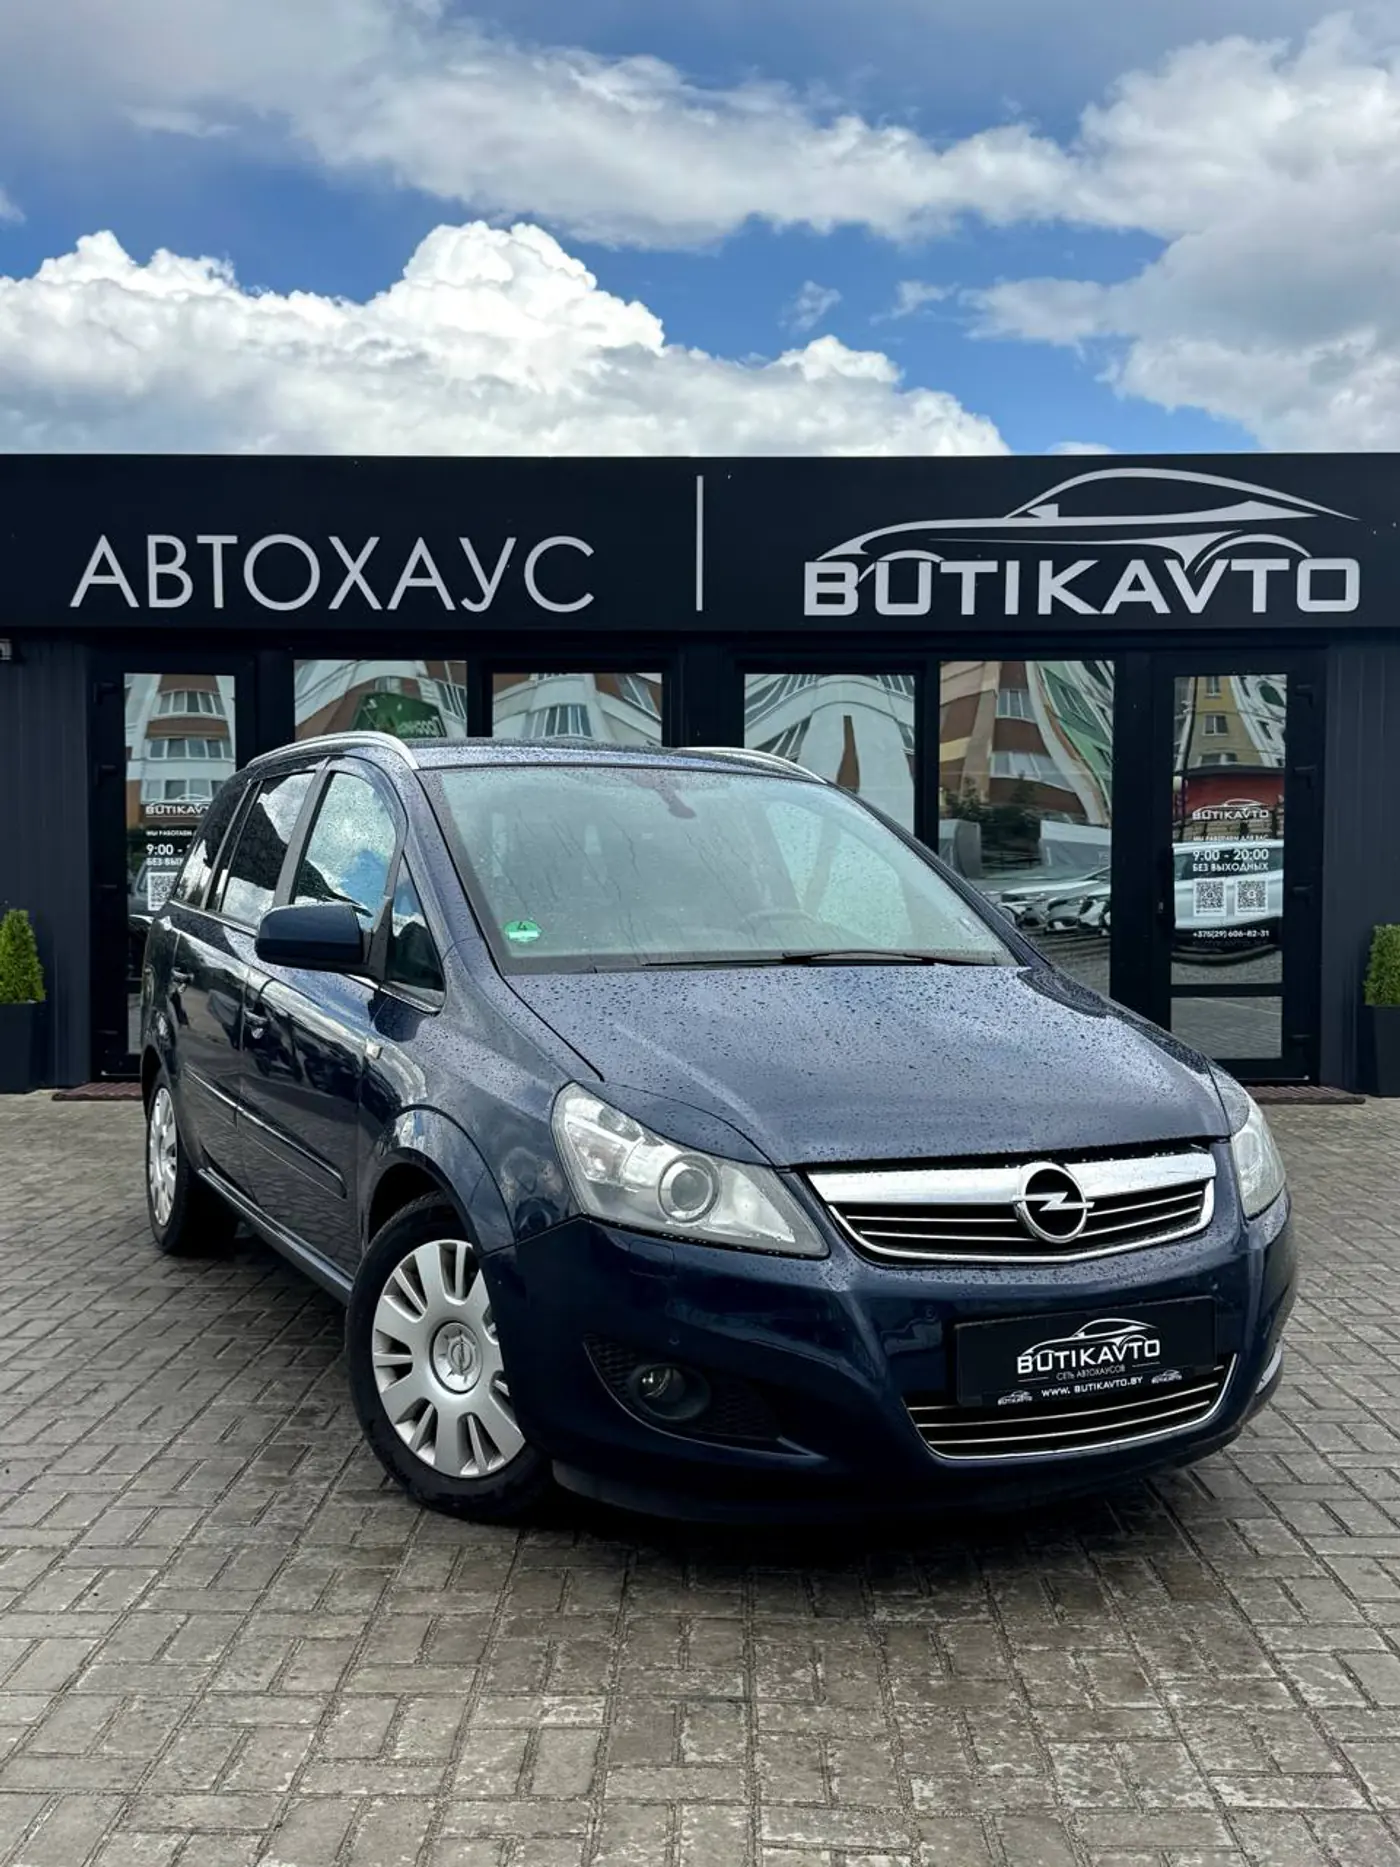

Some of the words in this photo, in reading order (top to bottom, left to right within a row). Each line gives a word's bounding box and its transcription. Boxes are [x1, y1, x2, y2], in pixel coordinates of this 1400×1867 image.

[70, 533, 595, 613] АВТОХАУС
[804, 557, 1361, 617] BUTIKAVTO
[1192, 809, 1269, 820] BUTIKAVTO
[146, 844, 173, 855] 9:00
[1193, 850, 1220, 861] 9:00
[1234, 849, 1269, 860] 20:00
[146, 858, 162, 866] БЕЗ
[1193, 863, 1209, 872] БЕЗ
[1211, 862, 1268, 872] ВЫХОДНЫХ
[1017, 1339, 1160, 1375] BUTIKAVTO
